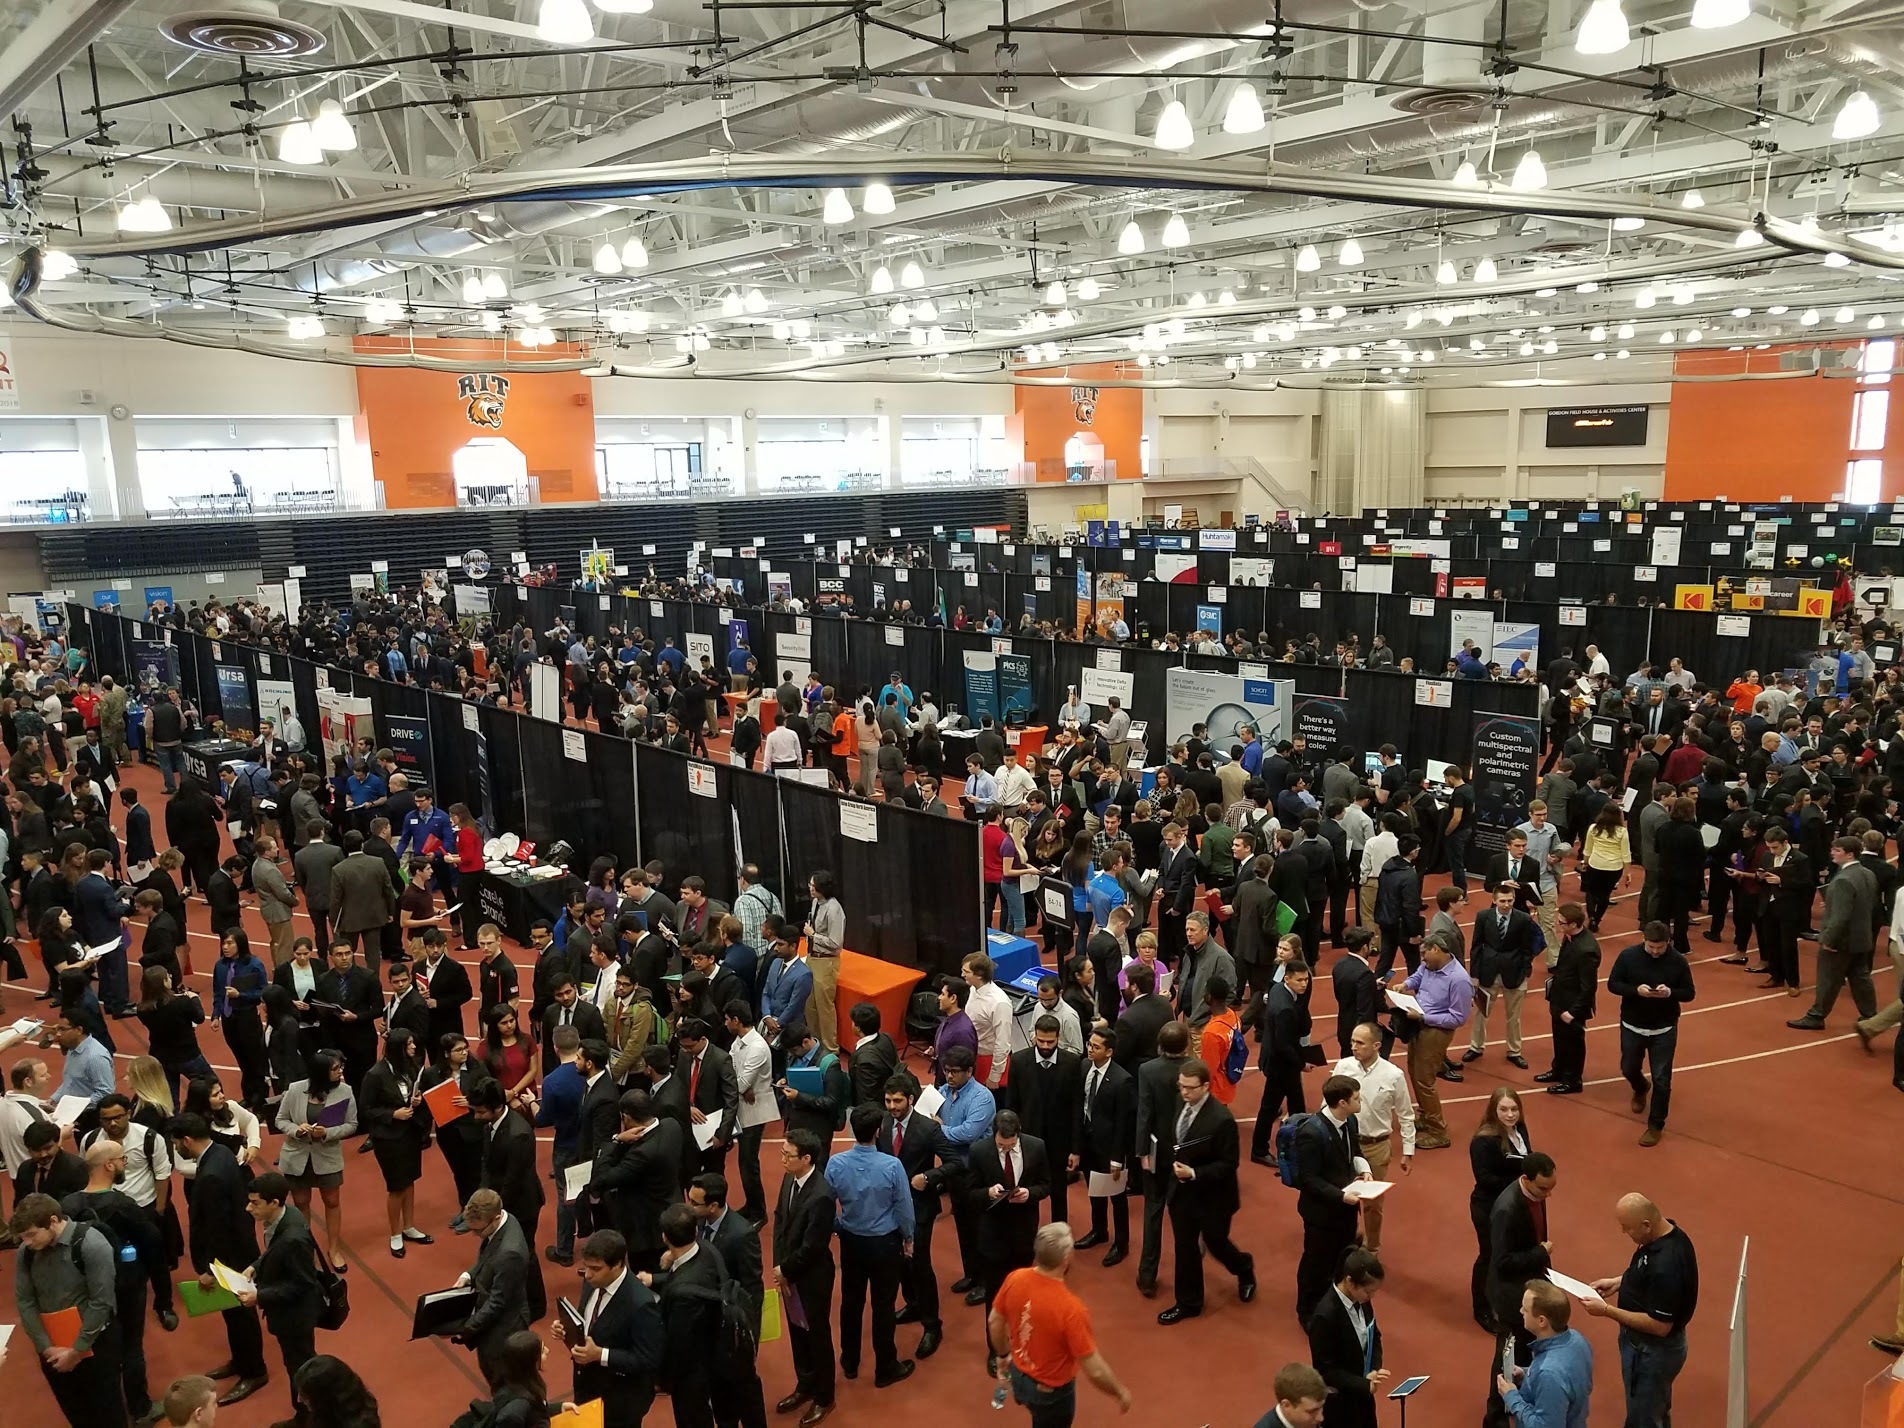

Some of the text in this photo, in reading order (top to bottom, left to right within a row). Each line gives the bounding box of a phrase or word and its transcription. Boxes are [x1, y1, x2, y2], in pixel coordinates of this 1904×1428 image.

[458, 374, 509, 399] RIT
[1071, 387, 1098, 403] RIT
[1202, 532, 1234, 540] Huhtamaki
[820, 580, 844, 588] BCC
[1207, 611, 1217, 620] SMC
[690, 641, 710, 653] SITO
[219, 669, 245, 682] Ursa
[1251, 686, 1267, 694] SCHOTT
[1302, 715, 1328, 725] There's
[390, 728, 415, 740] DRIVE
[1299, 723, 1337, 735] better way
[1306, 734, 1337, 743] measure
[1489, 731, 1522, 743] Custom
[1308, 742, 1328, 751] color.
[1477, 740, 1533, 754] multispectral
[1496, 751, 1513, 760] and
[1478, 757, 1530, 770] polarimetric
[1486, 766, 1522, 778] cameras
[480, 898, 508, 928] Brands
